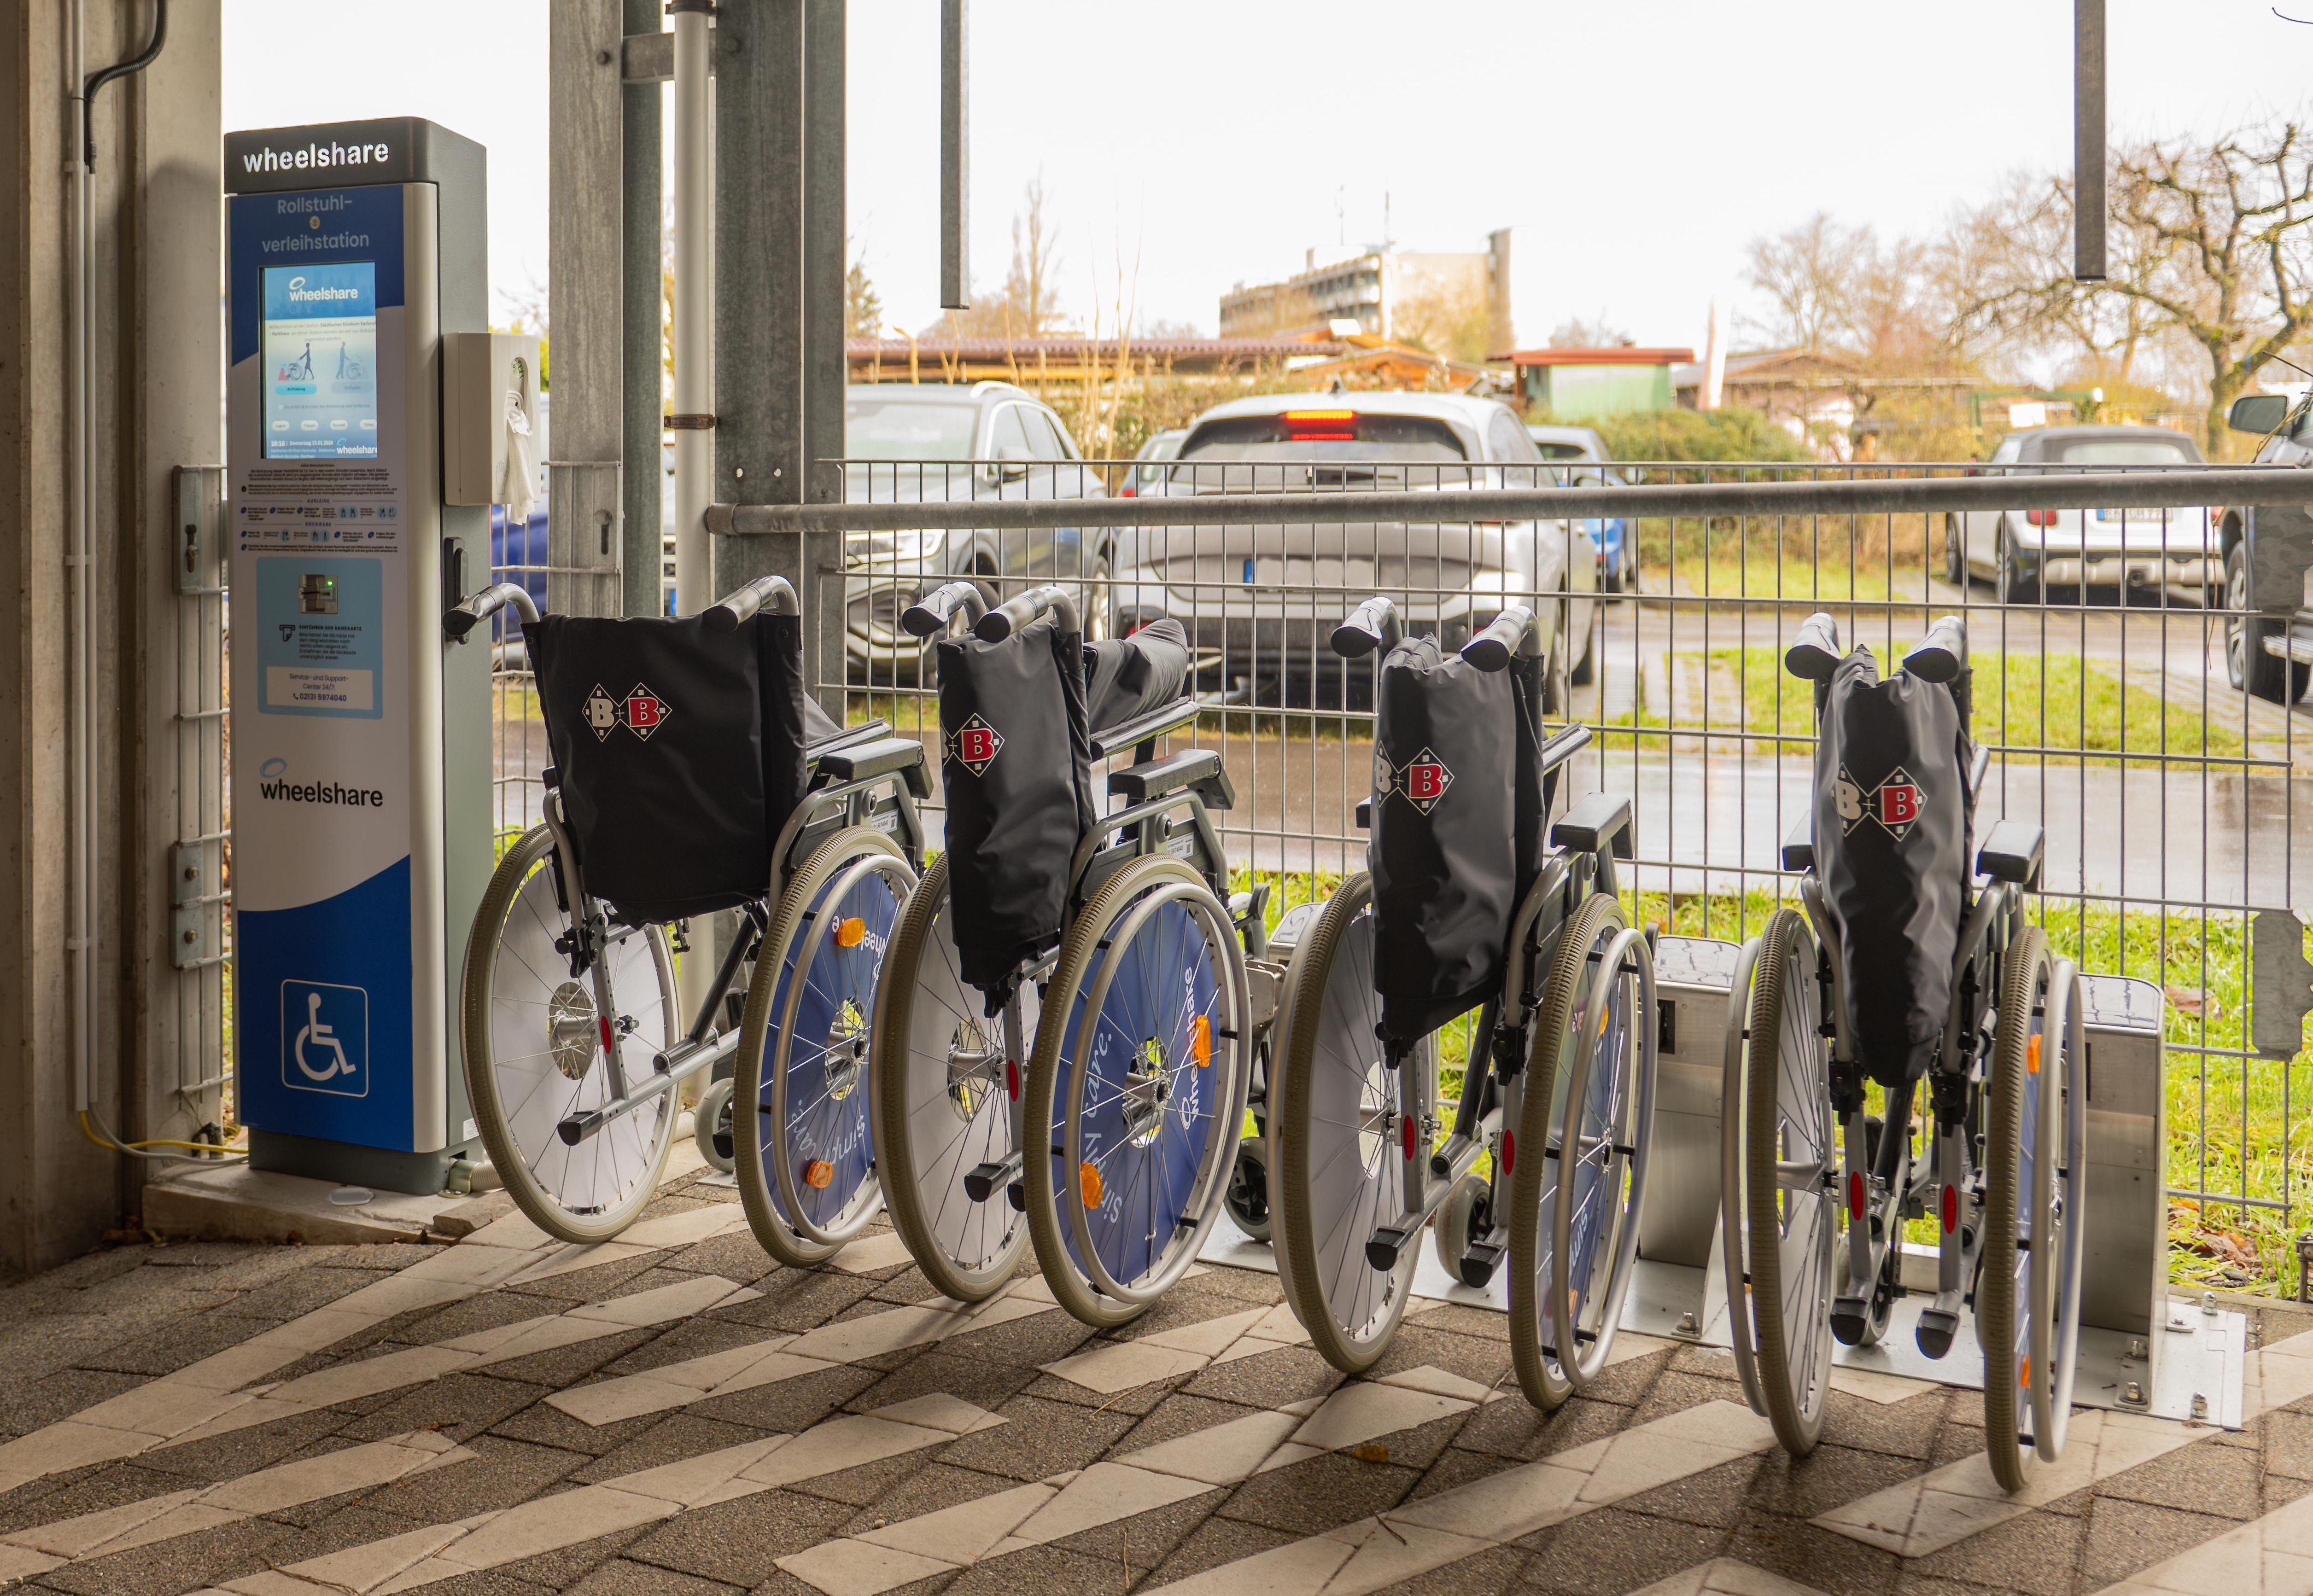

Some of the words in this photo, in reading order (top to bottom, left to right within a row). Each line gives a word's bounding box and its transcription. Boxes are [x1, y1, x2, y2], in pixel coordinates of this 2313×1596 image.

[244, 141, 389, 173] wheelshare
[278, 195, 352, 214] Rollstuhl-
[262, 232, 369, 252] verleihstation
[289, 286, 358, 301] wheelshare
[260, 778, 383, 807] wheelshare
[1085, 1033, 1112, 1118] care.
